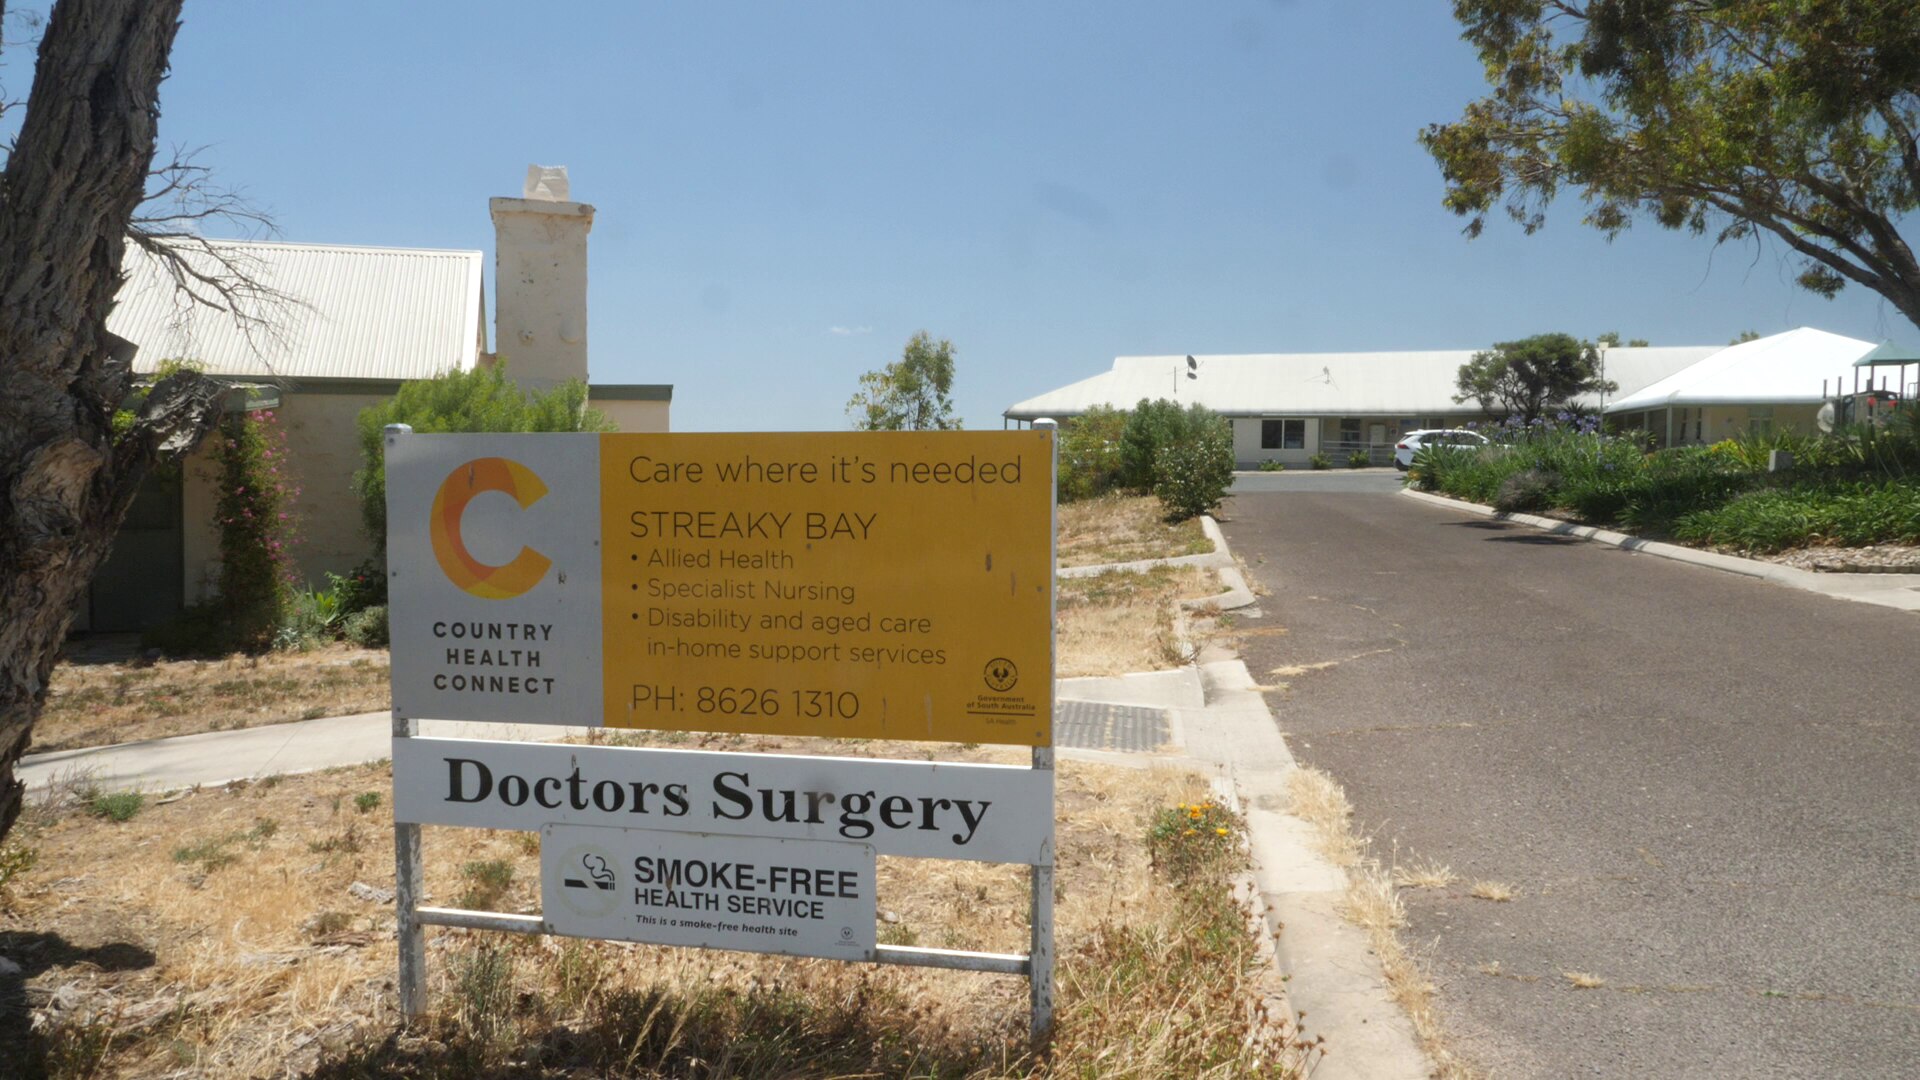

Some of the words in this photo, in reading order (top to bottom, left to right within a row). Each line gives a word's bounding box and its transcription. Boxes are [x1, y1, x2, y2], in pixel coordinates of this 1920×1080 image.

[629, 455, 703, 484] Care
[716, 454, 818, 484] where
[831, 454, 876, 484] it's
[890, 455, 1022, 485] needed
[630, 510, 792, 540] STREAKY
[806, 511, 877, 541] BAY
[647, 548, 711, 569] Allied
[720, 549, 794, 570] Health
[647, 577, 755, 602] Specialist
[765, 579, 855, 605] Nursing
[433, 621, 553, 641] COUNTRY
[648, 607, 752, 632] Disability
[760, 609, 803, 631] and
[811, 612, 871, 635] aged
[879, 616, 931, 634] care
[446, 648, 541, 667] HEALTH
[647, 637, 741, 658] in-home
[749, 642, 840, 663] support
[850, 644, 946, 665] services
[433, 674, 555, 695] CONNECT
[632, 684, 685, 712] PH:
[696, 686, 780, 716] 8626
[792, 689, 860, 719] 1310
[1002, 703, 1036, 711] Australia
[443, 757, 690, 817] Doctors
[712, 771, 993, 846] Surgery
[634, 855, 859, 899] SMOKE-FREE
[635, 887, 719, 911] HEALTH
[727, 894, 825, 920] SERVICE
[636, 914, 657, 925] This
[660, 917, 667, 926] is
[679, 919, 739, 932] smoke-free
[742, 924, 776, 936] health
[779, 927, 798, 937] site
